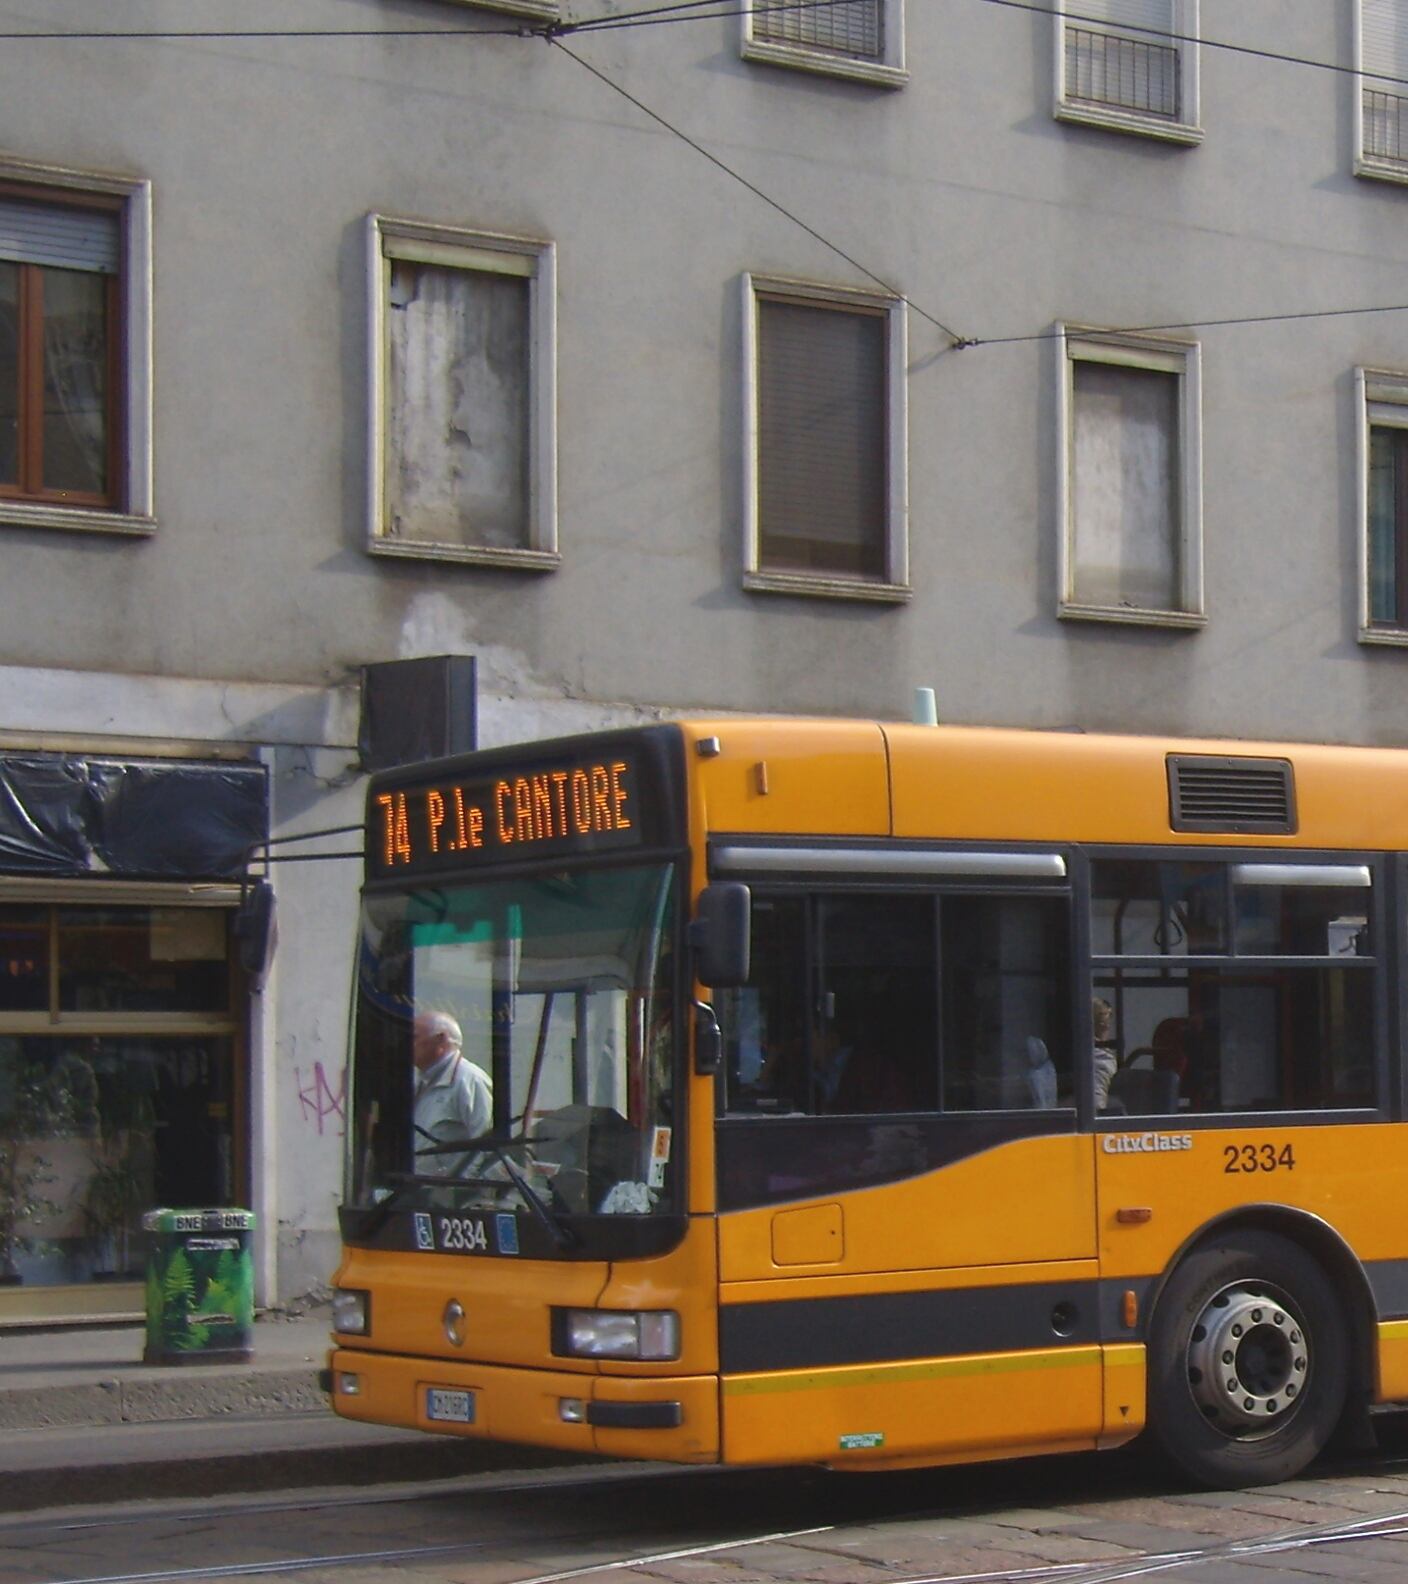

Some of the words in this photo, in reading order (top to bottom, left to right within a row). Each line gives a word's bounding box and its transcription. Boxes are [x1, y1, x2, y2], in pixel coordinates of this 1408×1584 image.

[378, 793, 411, 866] 74
[428, 787, 484, 853] P.le
[495, 761, 632, 844] CANTORE
[1103, 1132, 1193, 1154] CityClass
[1223, 1144, 1296, 1174] 2334
[441, 1217, 487, 1250] 2334
